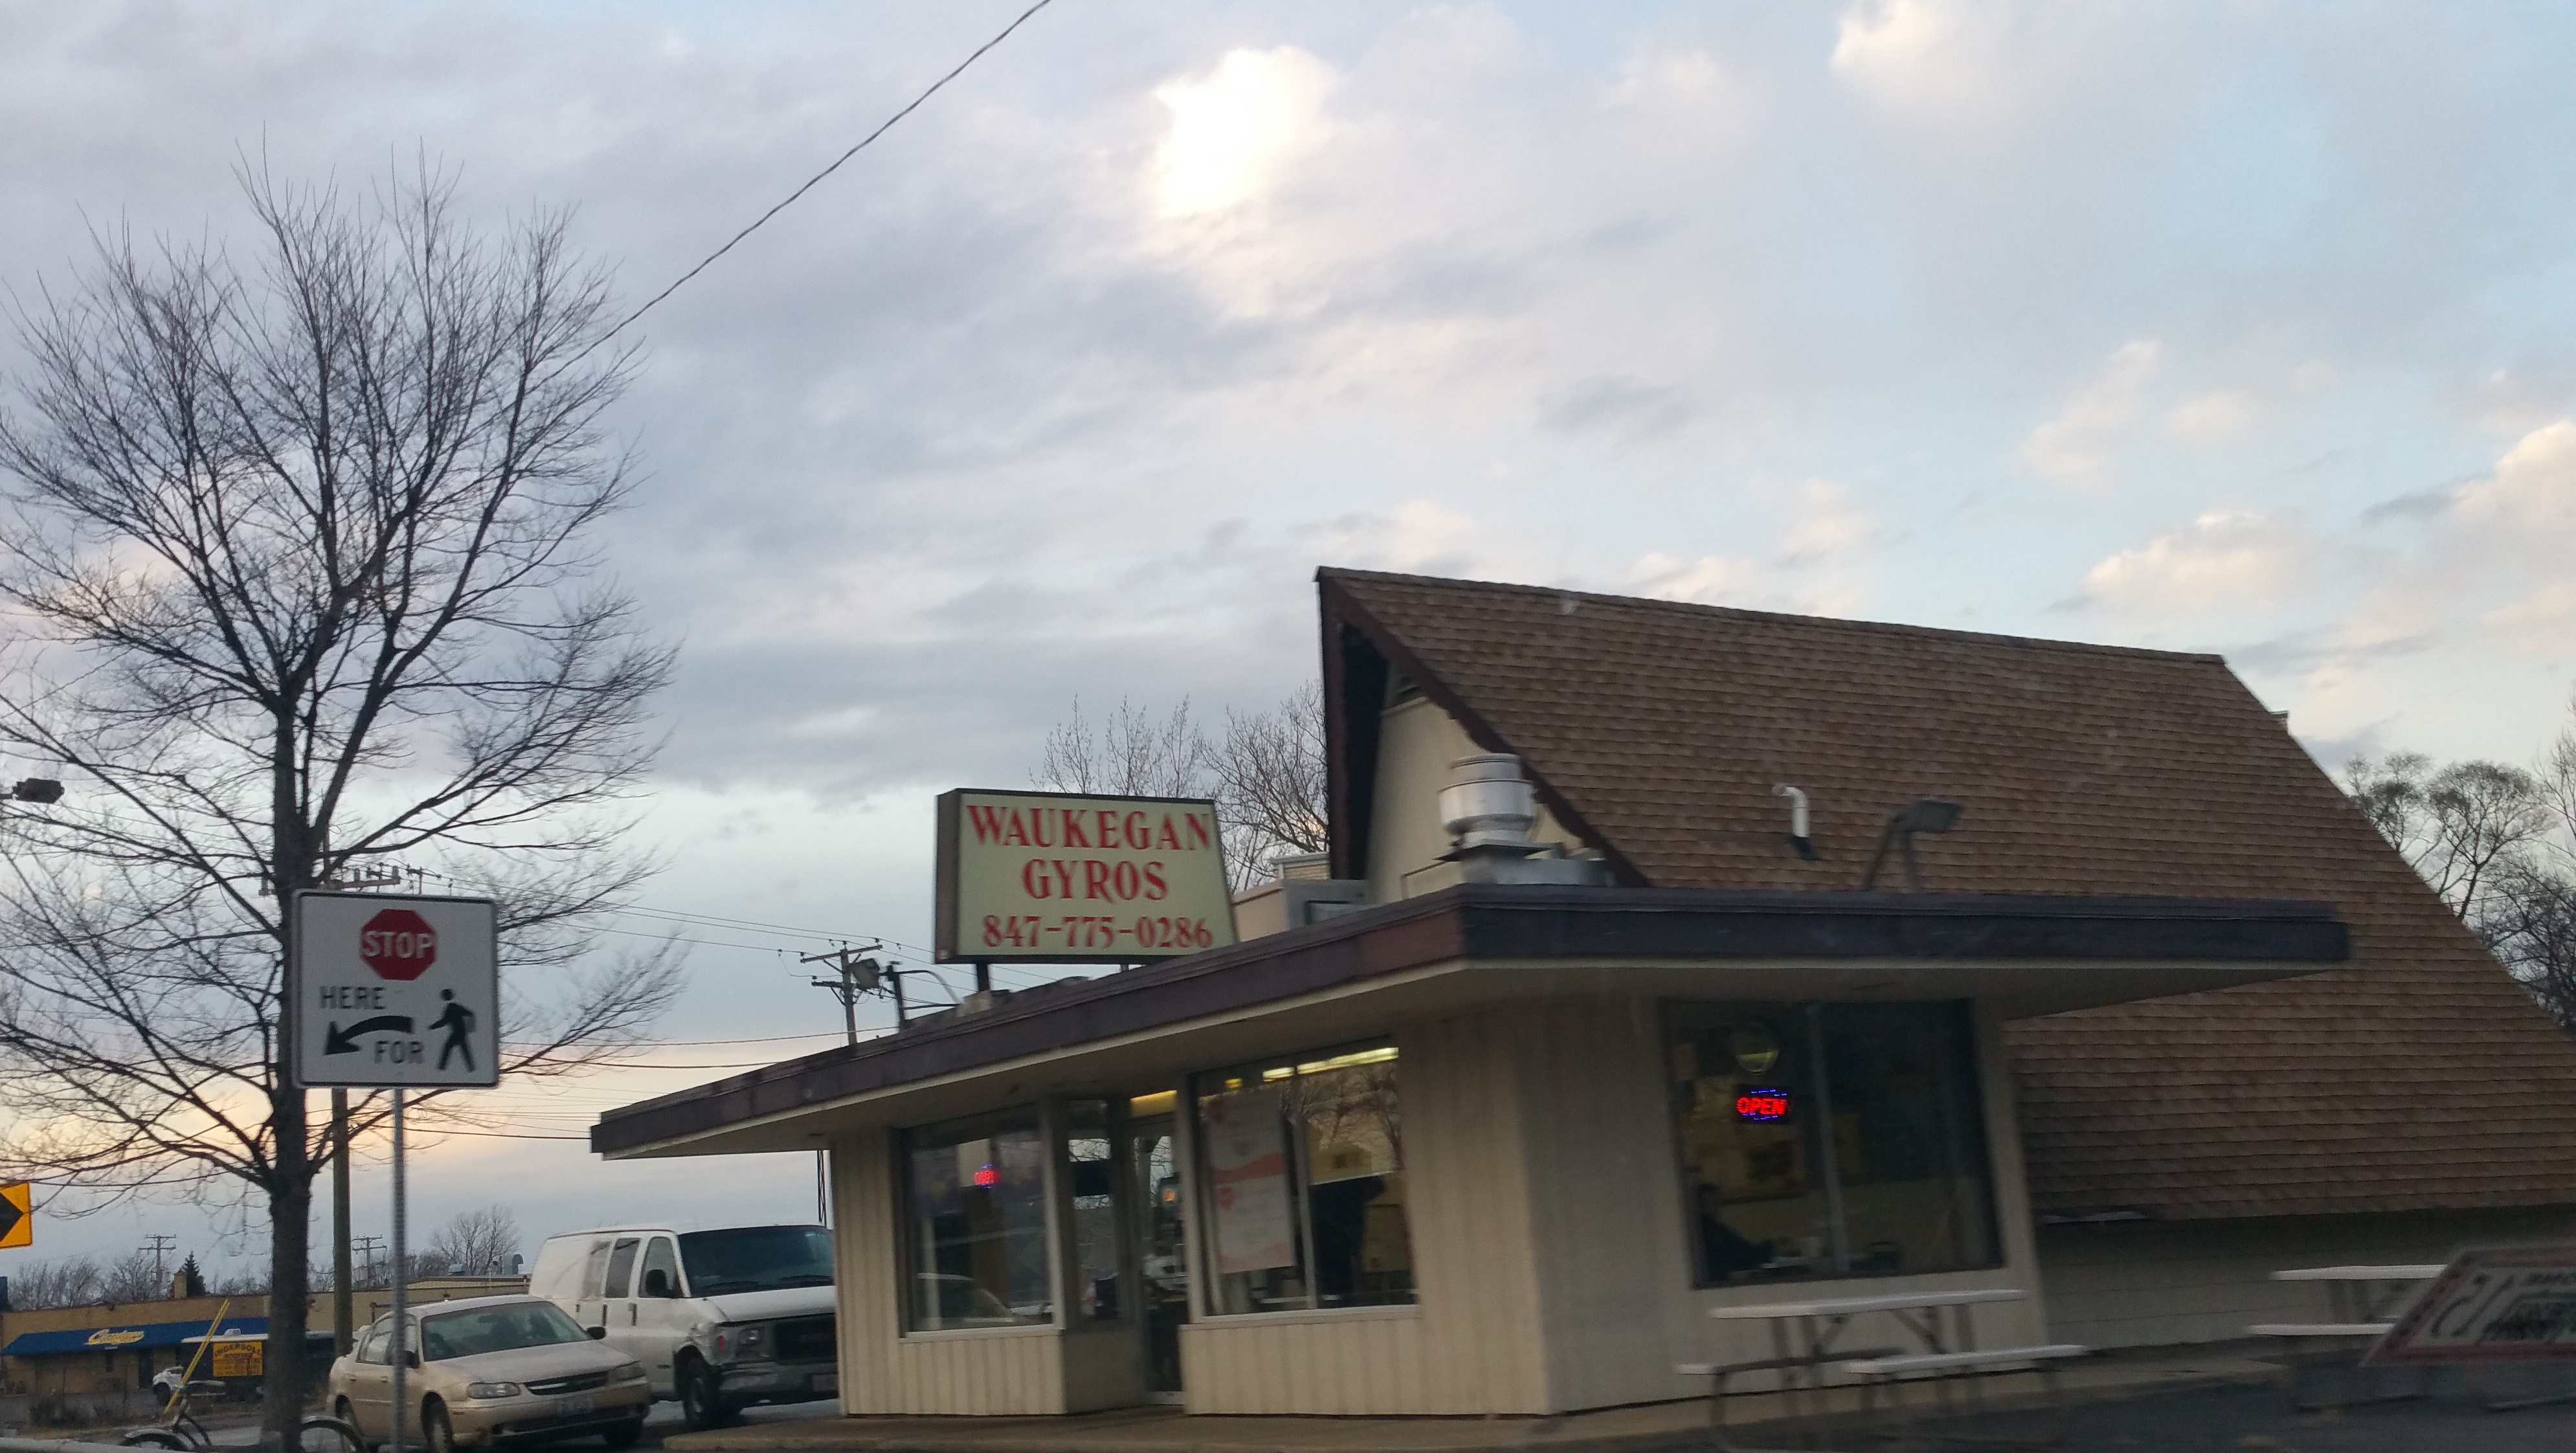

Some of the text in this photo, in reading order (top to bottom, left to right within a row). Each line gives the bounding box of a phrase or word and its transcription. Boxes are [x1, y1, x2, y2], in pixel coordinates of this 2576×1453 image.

[966, 804, 1211, 851] WAUKEGAN
[1022, 858, 1169, 904] GYROS
[363, 930, 434, 959] STOP
[982, 914, 1213, 949] 847-775-0286
[320, 986, 386, 1009] HERE
[374, 1039, 424, 1064] FOR
[1737, 1098, 1789, 1115] OPEN
